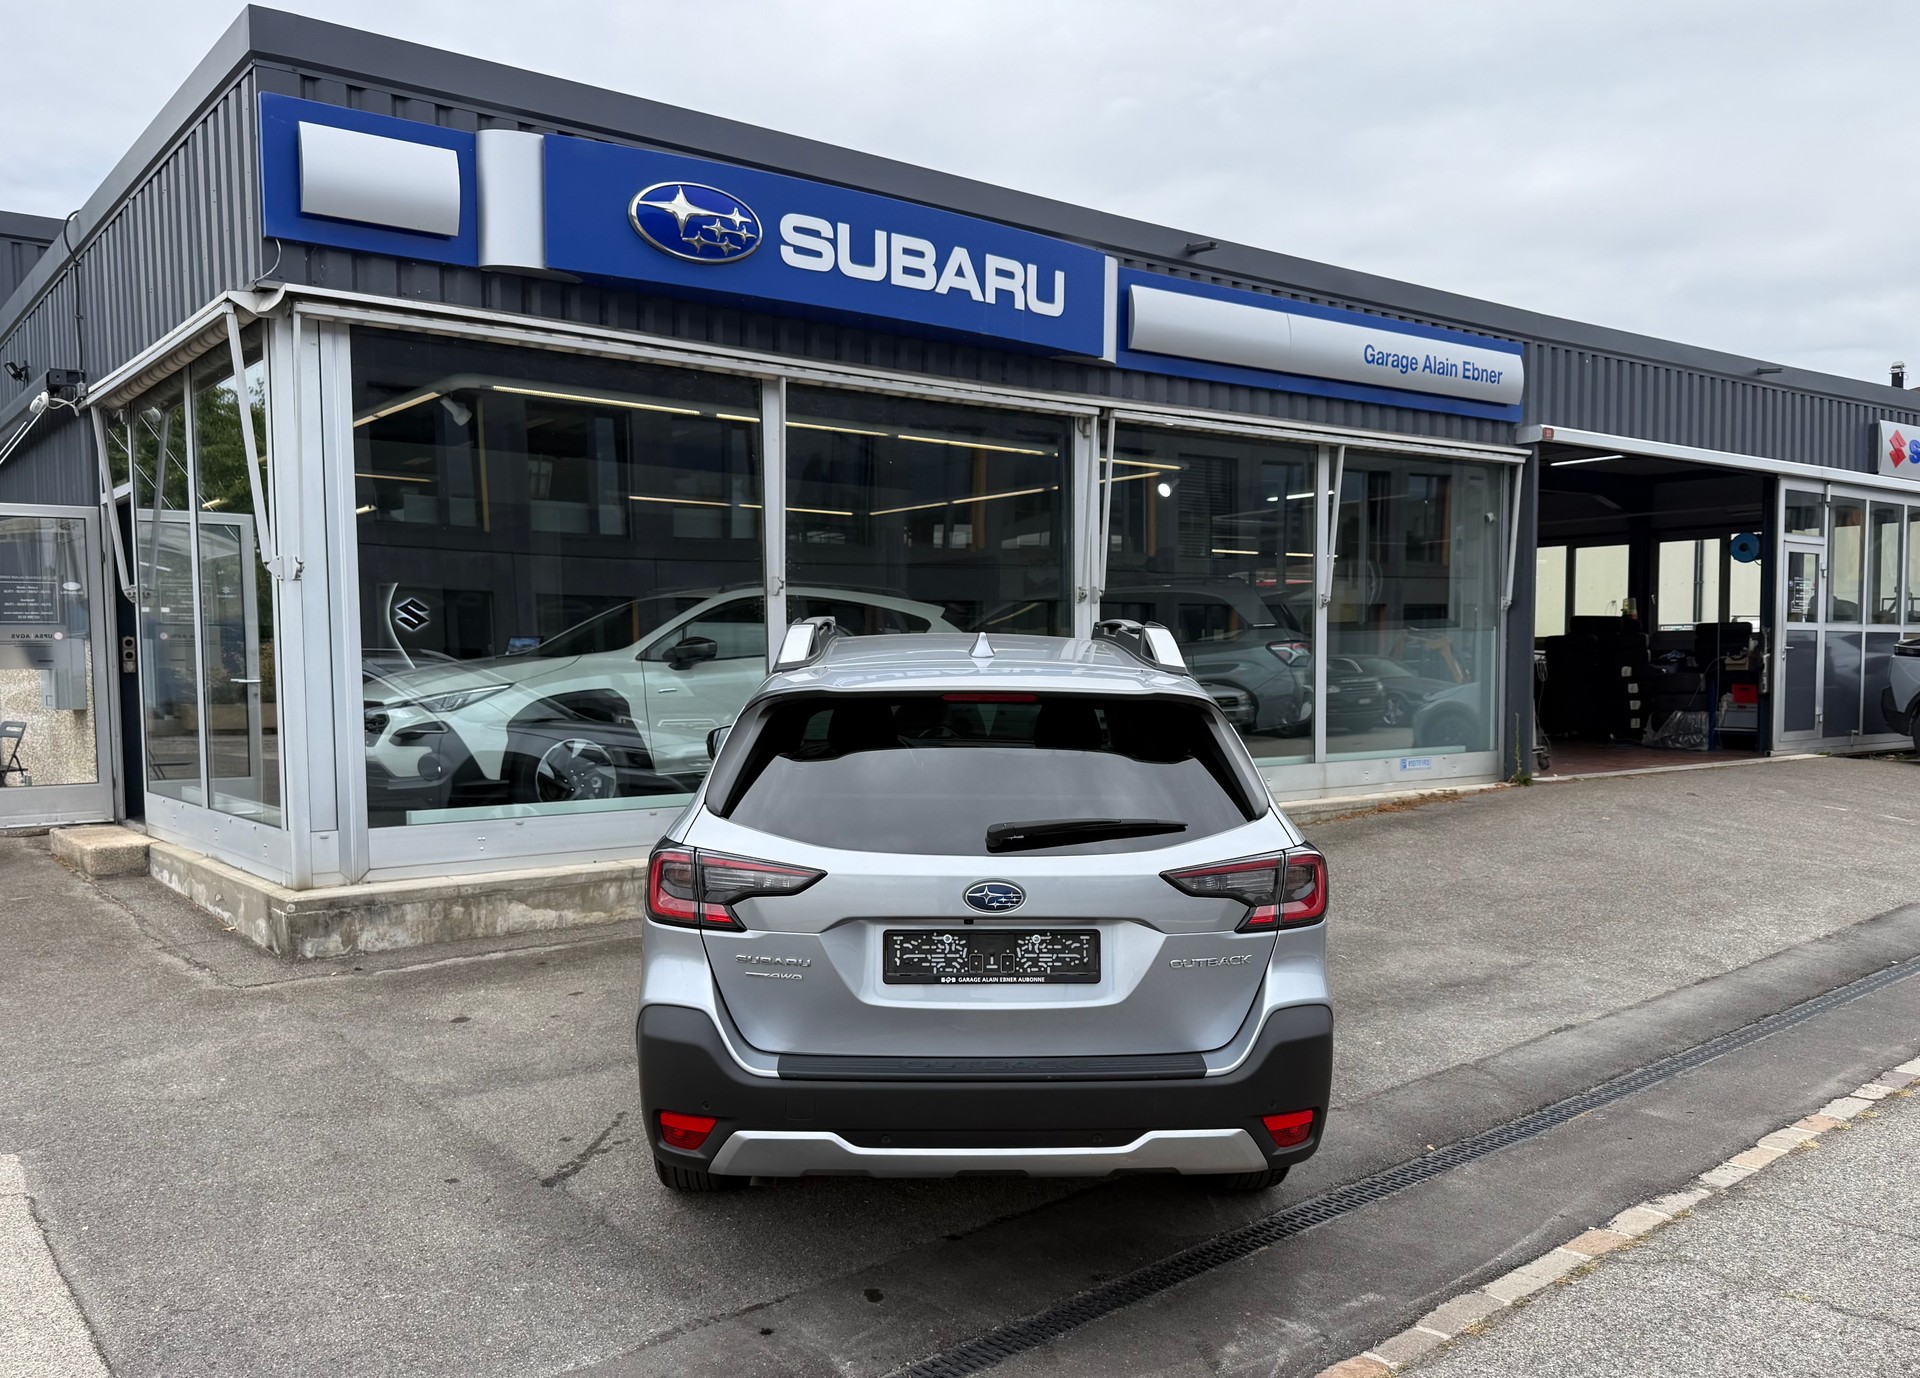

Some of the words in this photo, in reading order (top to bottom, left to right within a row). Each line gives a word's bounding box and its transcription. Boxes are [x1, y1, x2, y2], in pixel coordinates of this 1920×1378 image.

[779, 213, 1065, 317] SUBARU
[1364, 344, 1418, 374] Garage
[1422, 354, 1458, 378] Alain
[1462, 361, 1503, 384] Ebner
[735, 954, 812, 968] SUBARU
[1169, 954, 1253, 969] OUTBACK
[768, 972, 804, 981] AWD
